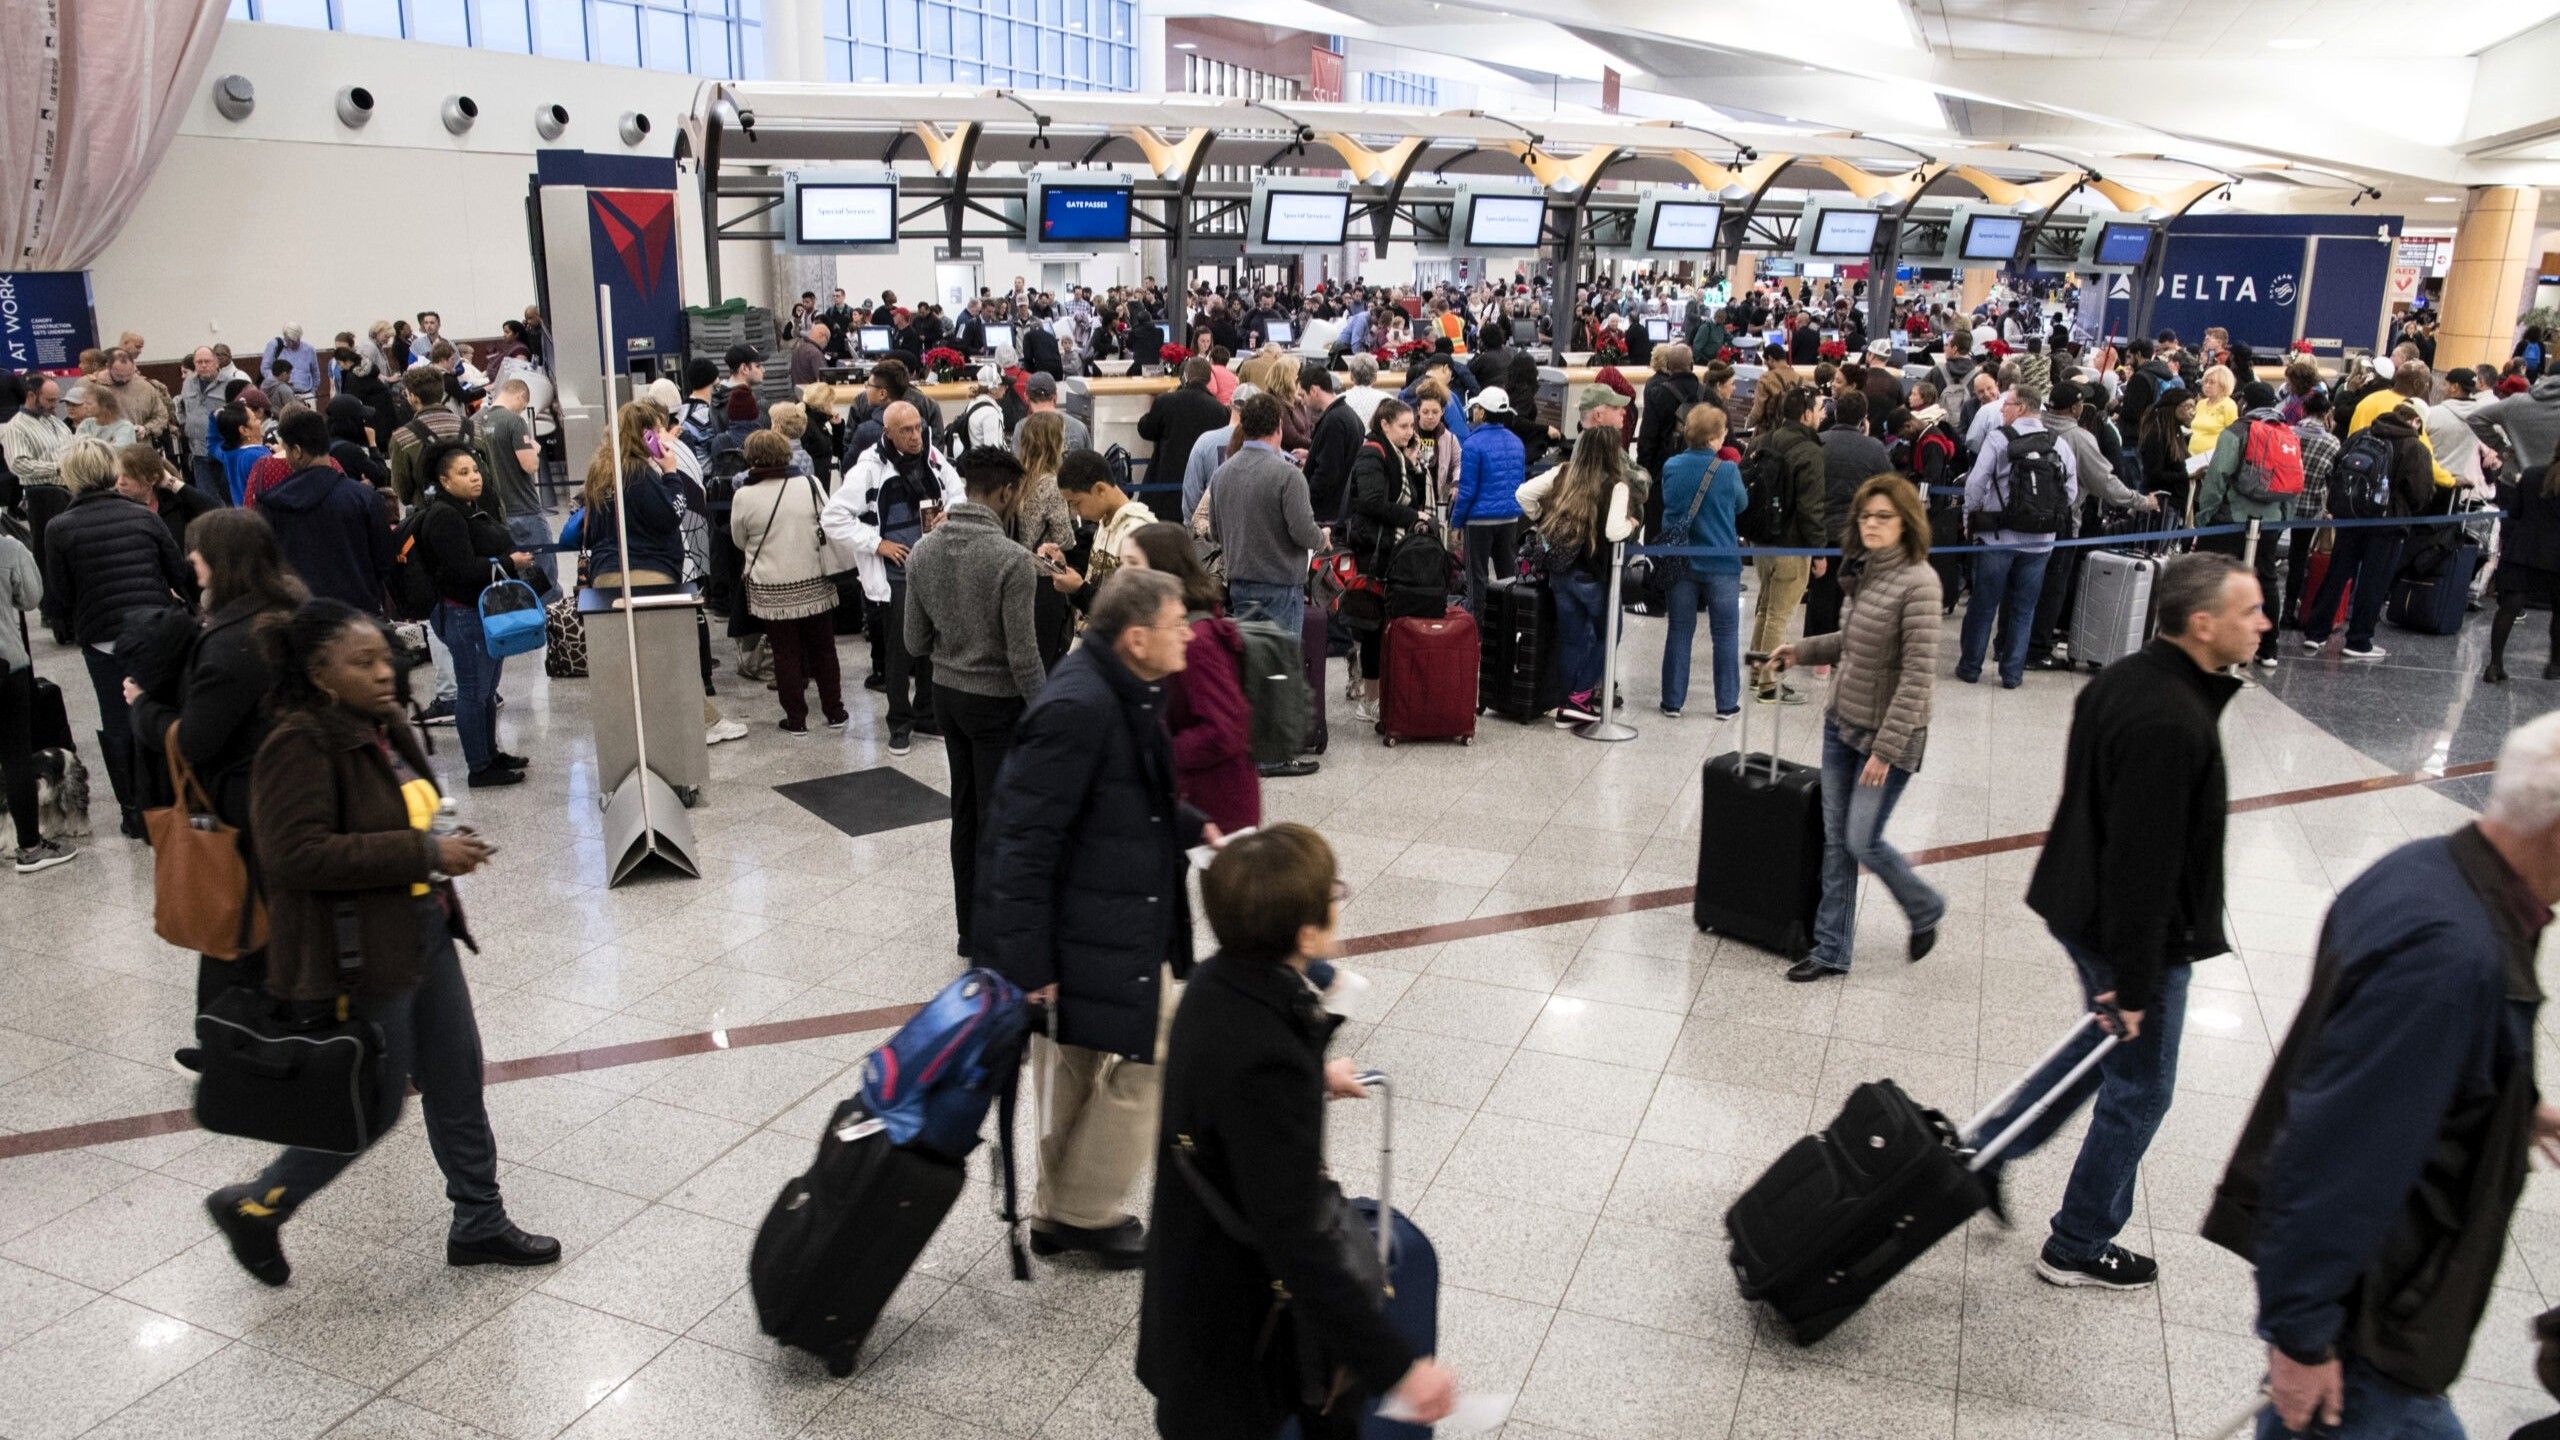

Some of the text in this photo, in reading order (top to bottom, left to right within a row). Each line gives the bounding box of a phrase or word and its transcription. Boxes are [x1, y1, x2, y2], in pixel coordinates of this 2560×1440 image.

[786, 171, 799, 181] 75
[885, 172, 897, 182] 76
[1031, 172, 1042, 182] 77
[1121, 174, 1132, 183] 78
[1255, 177, 1267, 187] 79
[1337, 180, 1348, 189] 80
[1458, 183, 1467, 192] 81
[1084, 201, 1108, 209] PASSES
[818, 208, 844, 216] Special
[0, 275, 20, 333] WORK
[9, 340, 27, 361] AT
